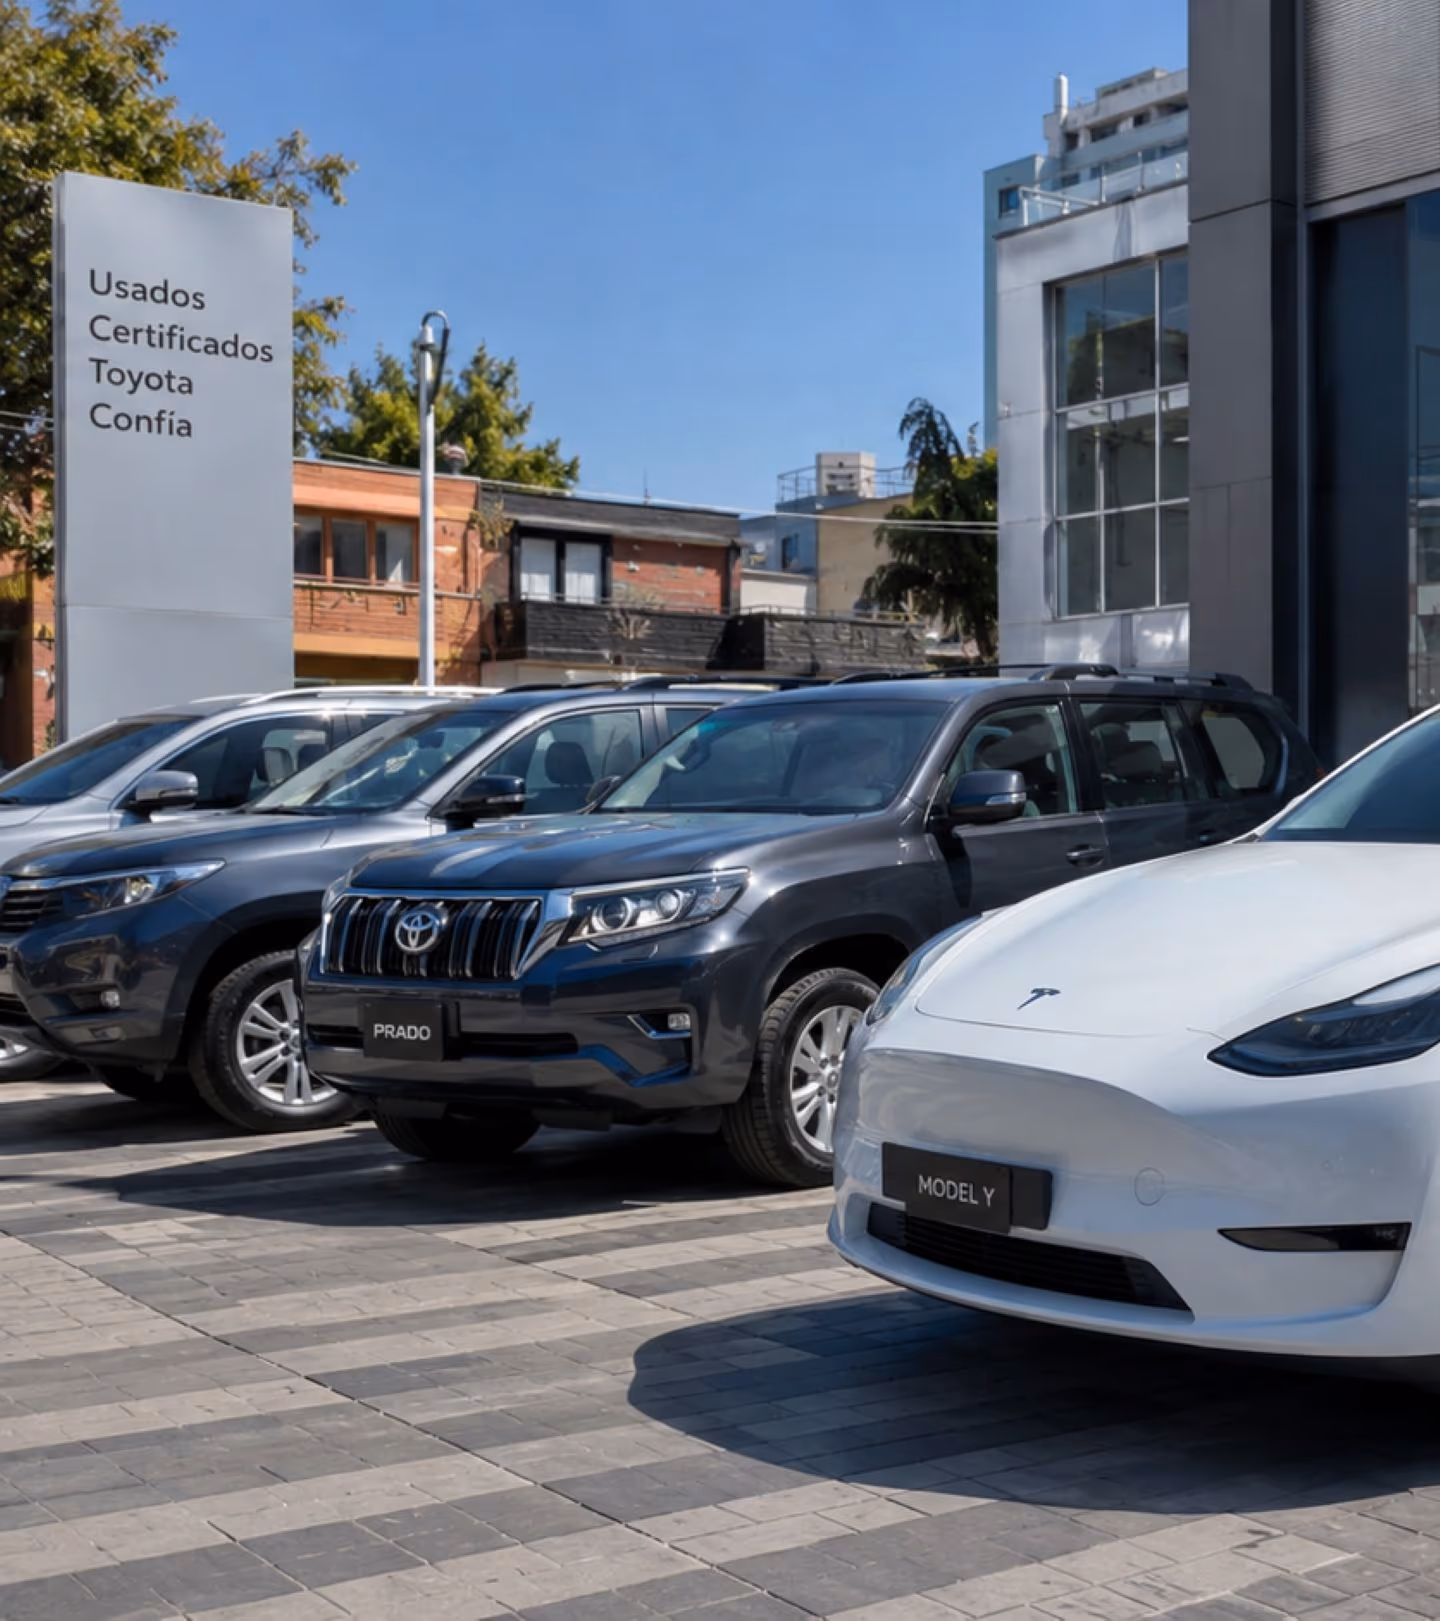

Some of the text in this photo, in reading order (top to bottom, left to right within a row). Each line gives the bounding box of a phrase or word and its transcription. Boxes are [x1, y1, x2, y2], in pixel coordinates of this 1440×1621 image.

[89, 268, 206, 310] Usados
[89, 314, 274, 362] Certificados
[89, 357, 193, 395] Toyota
[89, 403, 193, 437] Confía
[373, 1023, 431, 1040] PRADO
[918, 1174, 996, 1207] MODEL Y
